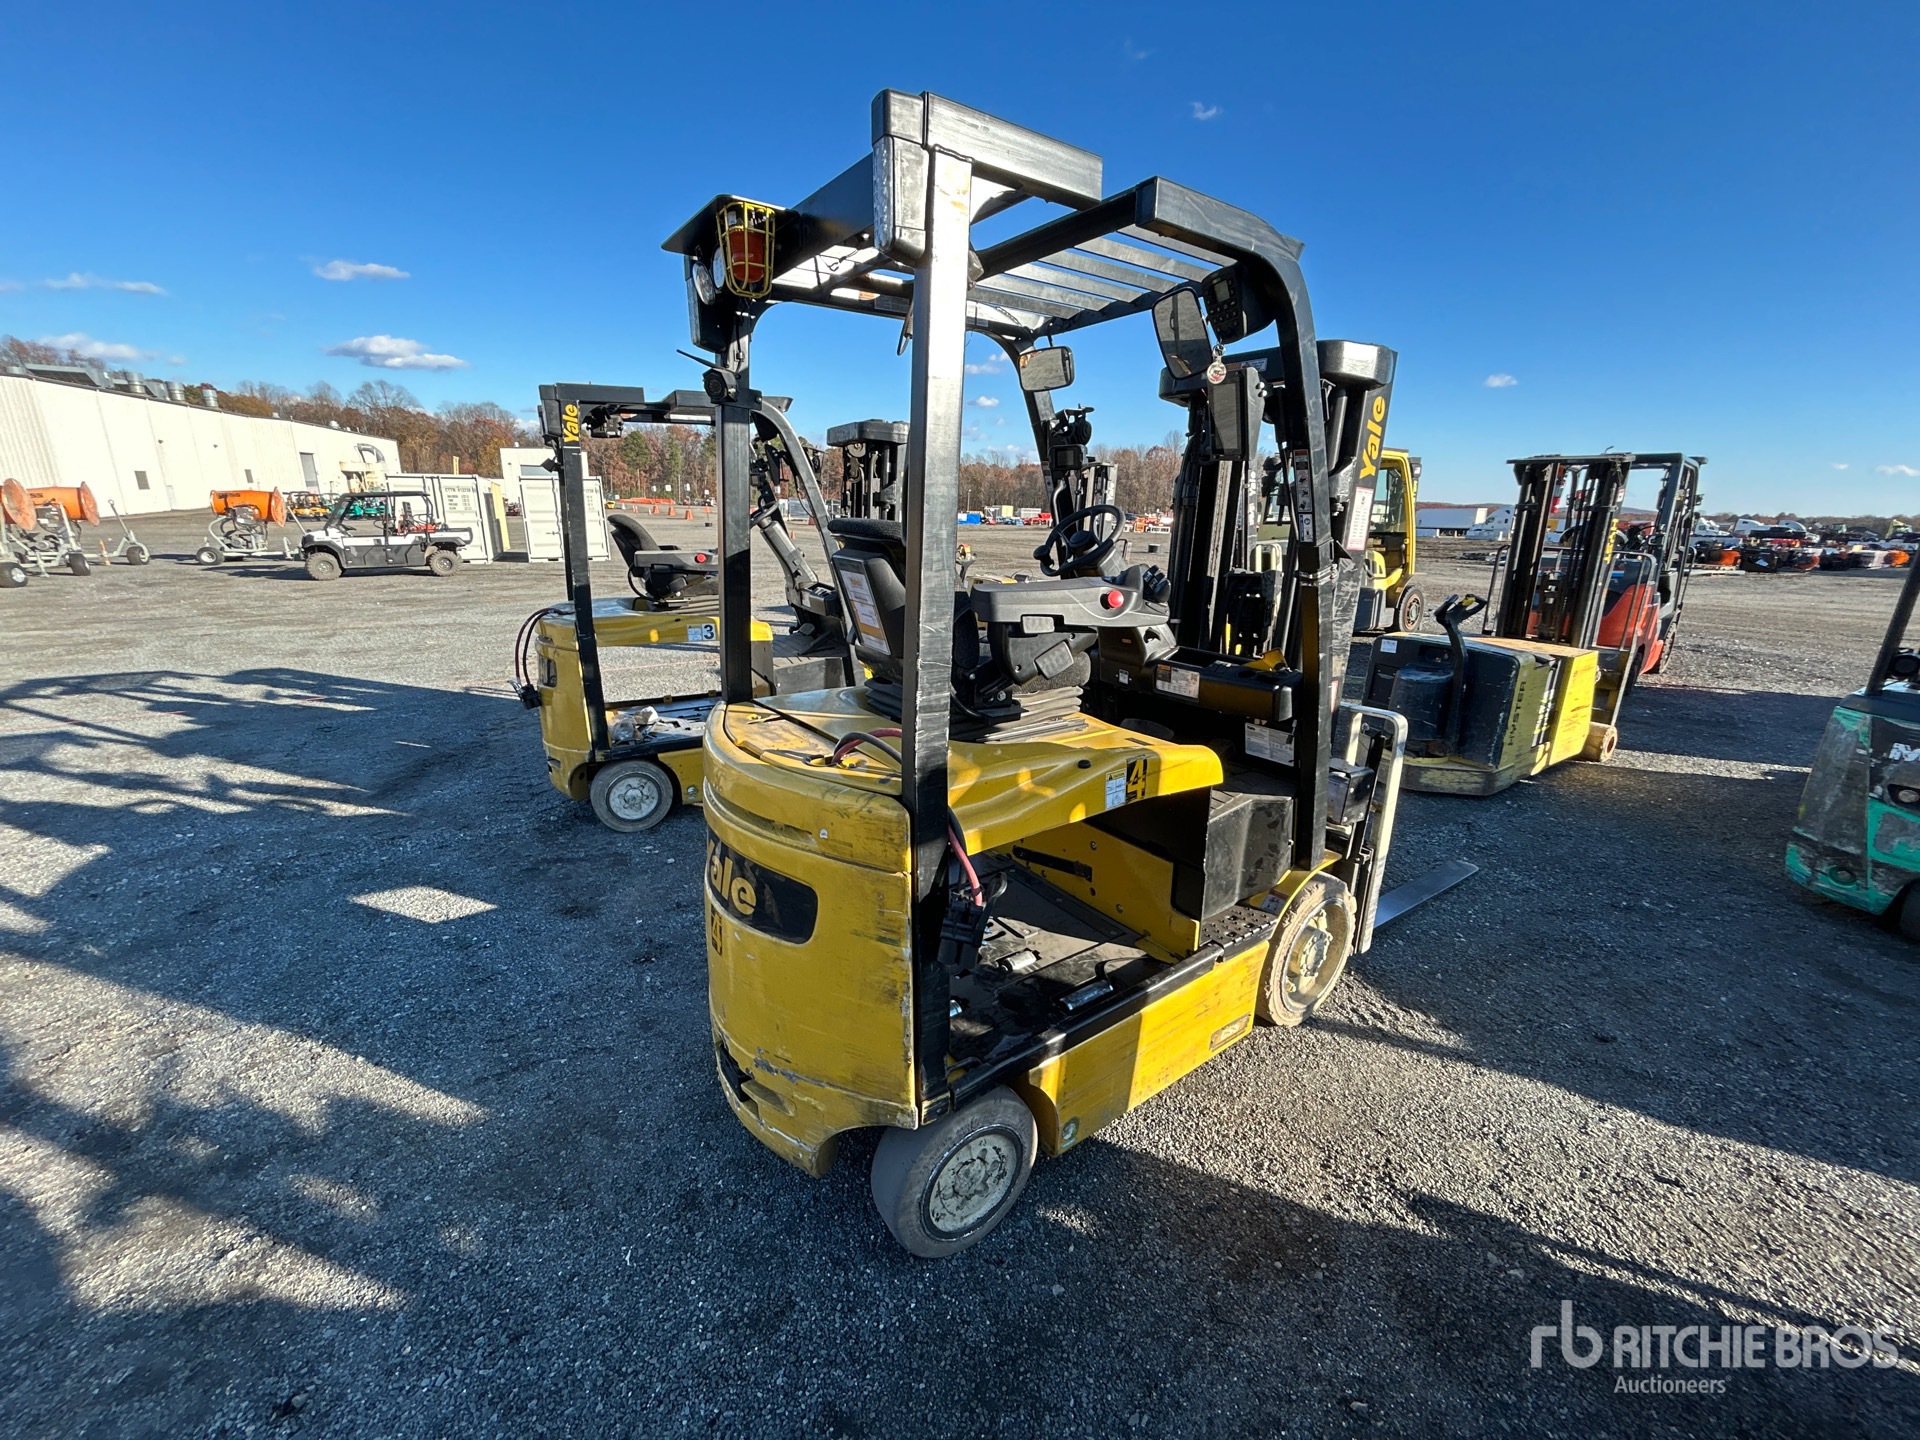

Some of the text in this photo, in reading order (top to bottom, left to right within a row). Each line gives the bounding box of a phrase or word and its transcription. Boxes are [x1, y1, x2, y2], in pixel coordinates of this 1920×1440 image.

[562, 403, 579, 443] Yale
[1359, 395, 1386, 479] Yale
[703, 624, 715, 640] 3
[1507, 681, 1527, 746] HYSTER
